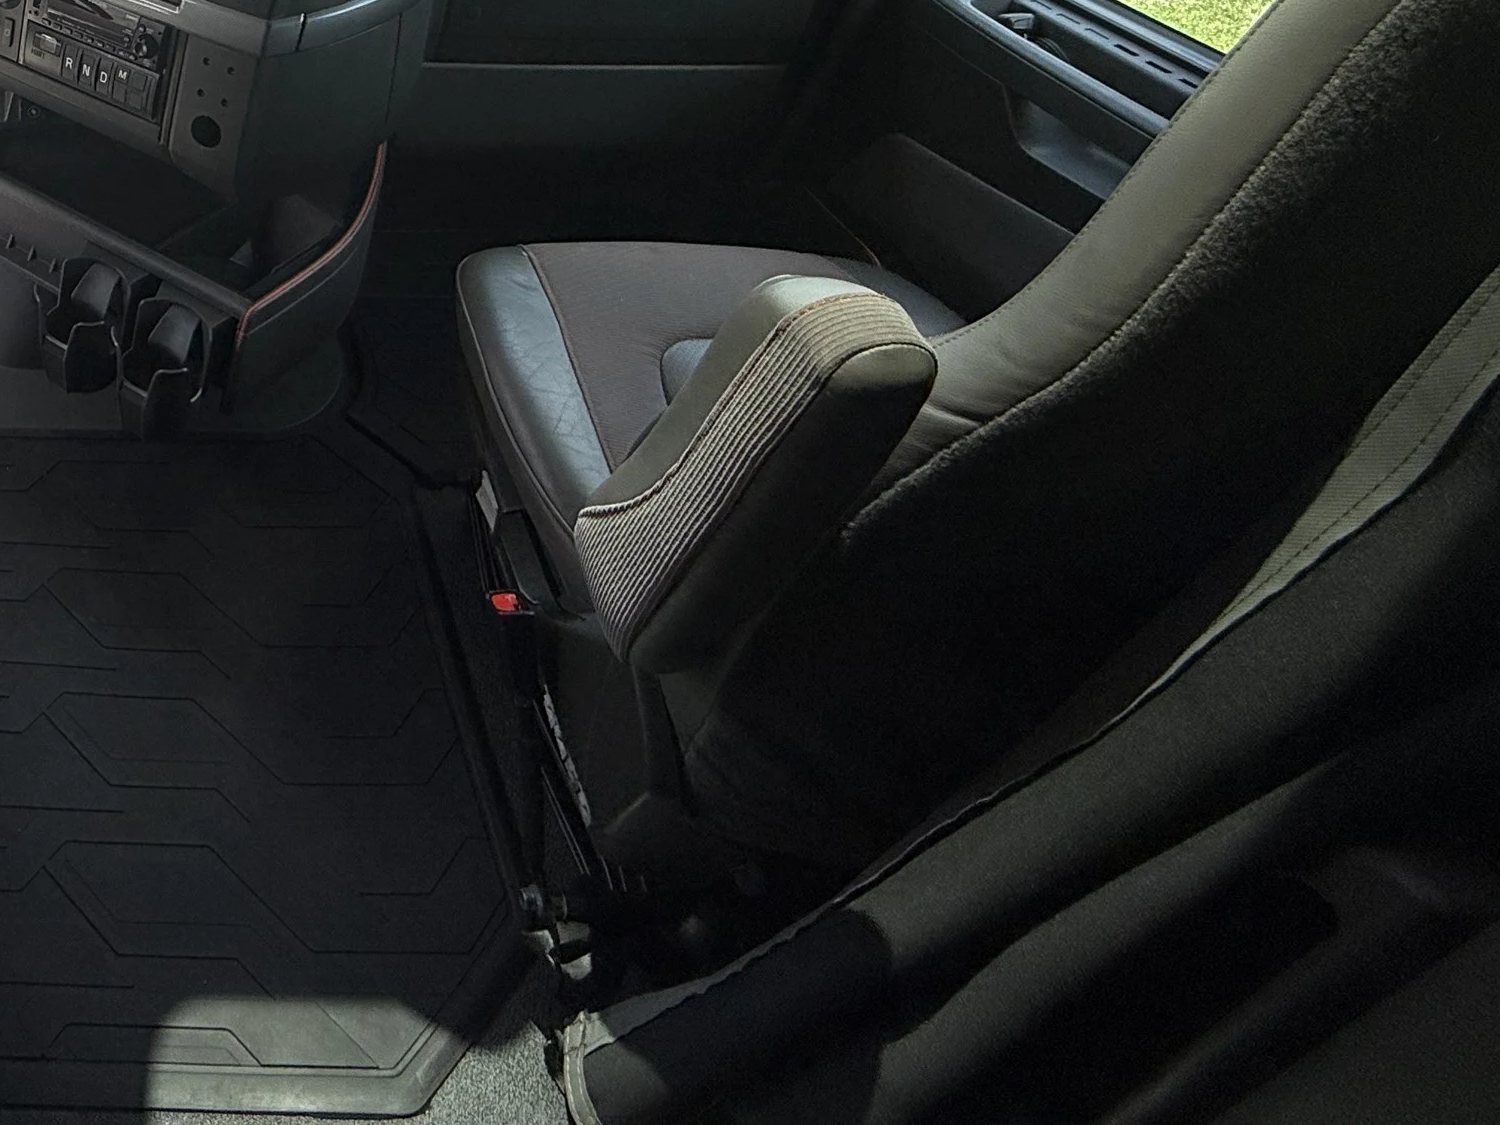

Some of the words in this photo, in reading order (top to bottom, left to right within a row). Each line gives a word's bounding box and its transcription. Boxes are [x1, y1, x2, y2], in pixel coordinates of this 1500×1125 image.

[65, 57, 73, 70] R
[82, 64, 91, 77] N
[99, 71, 108, 83] D
[118, 69, 127, 80] M
